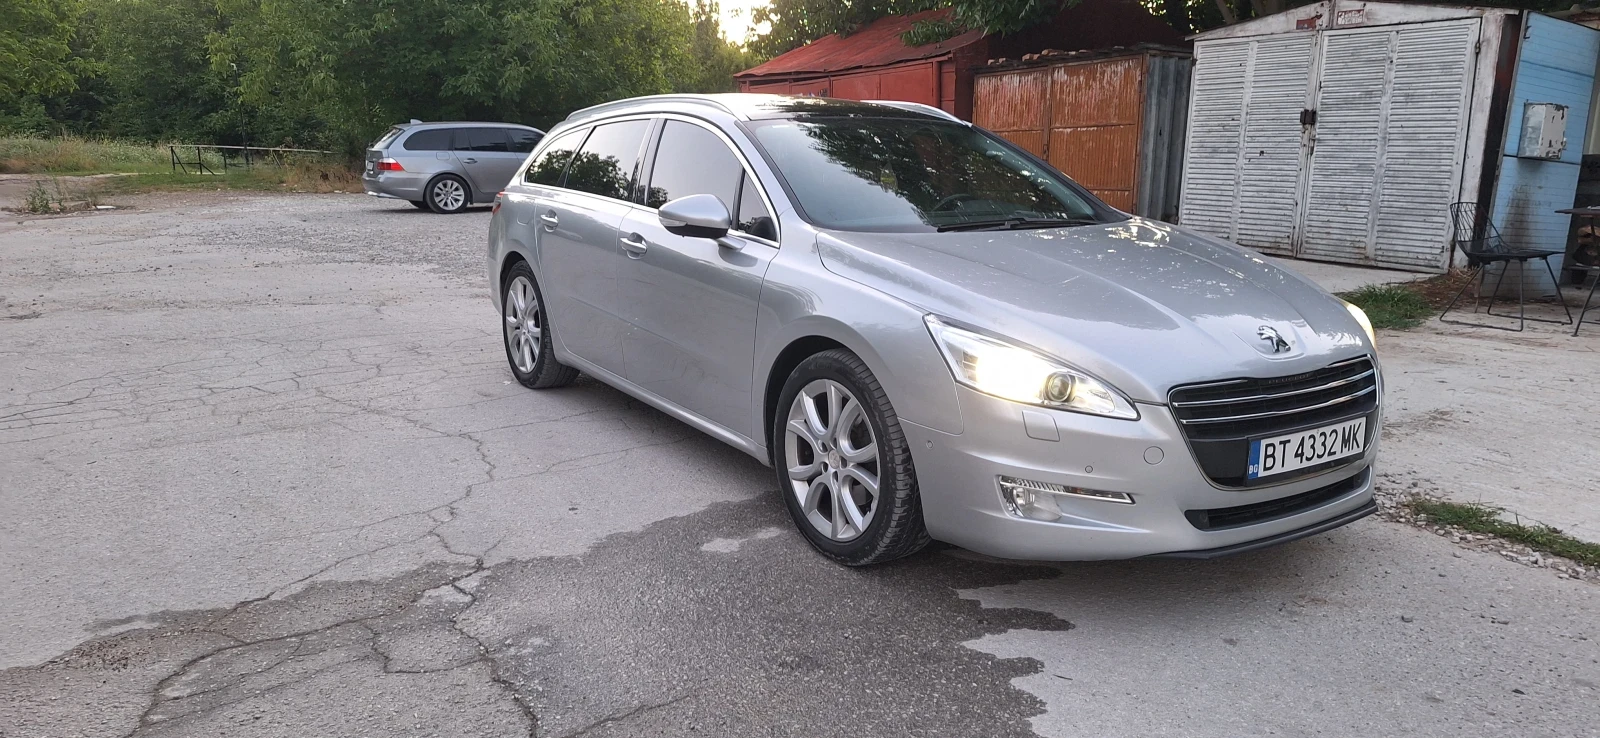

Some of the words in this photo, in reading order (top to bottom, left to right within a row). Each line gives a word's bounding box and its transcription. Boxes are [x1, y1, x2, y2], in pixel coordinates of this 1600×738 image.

[1268, 373, 1309, 384] PEUGEOT
[1263, 439, 1291, 471] BT
[1294, 429, 1338, 463] 4332
[1340, 422, 1362, 454] MK
[1249, 464, 1258, 474] BG
